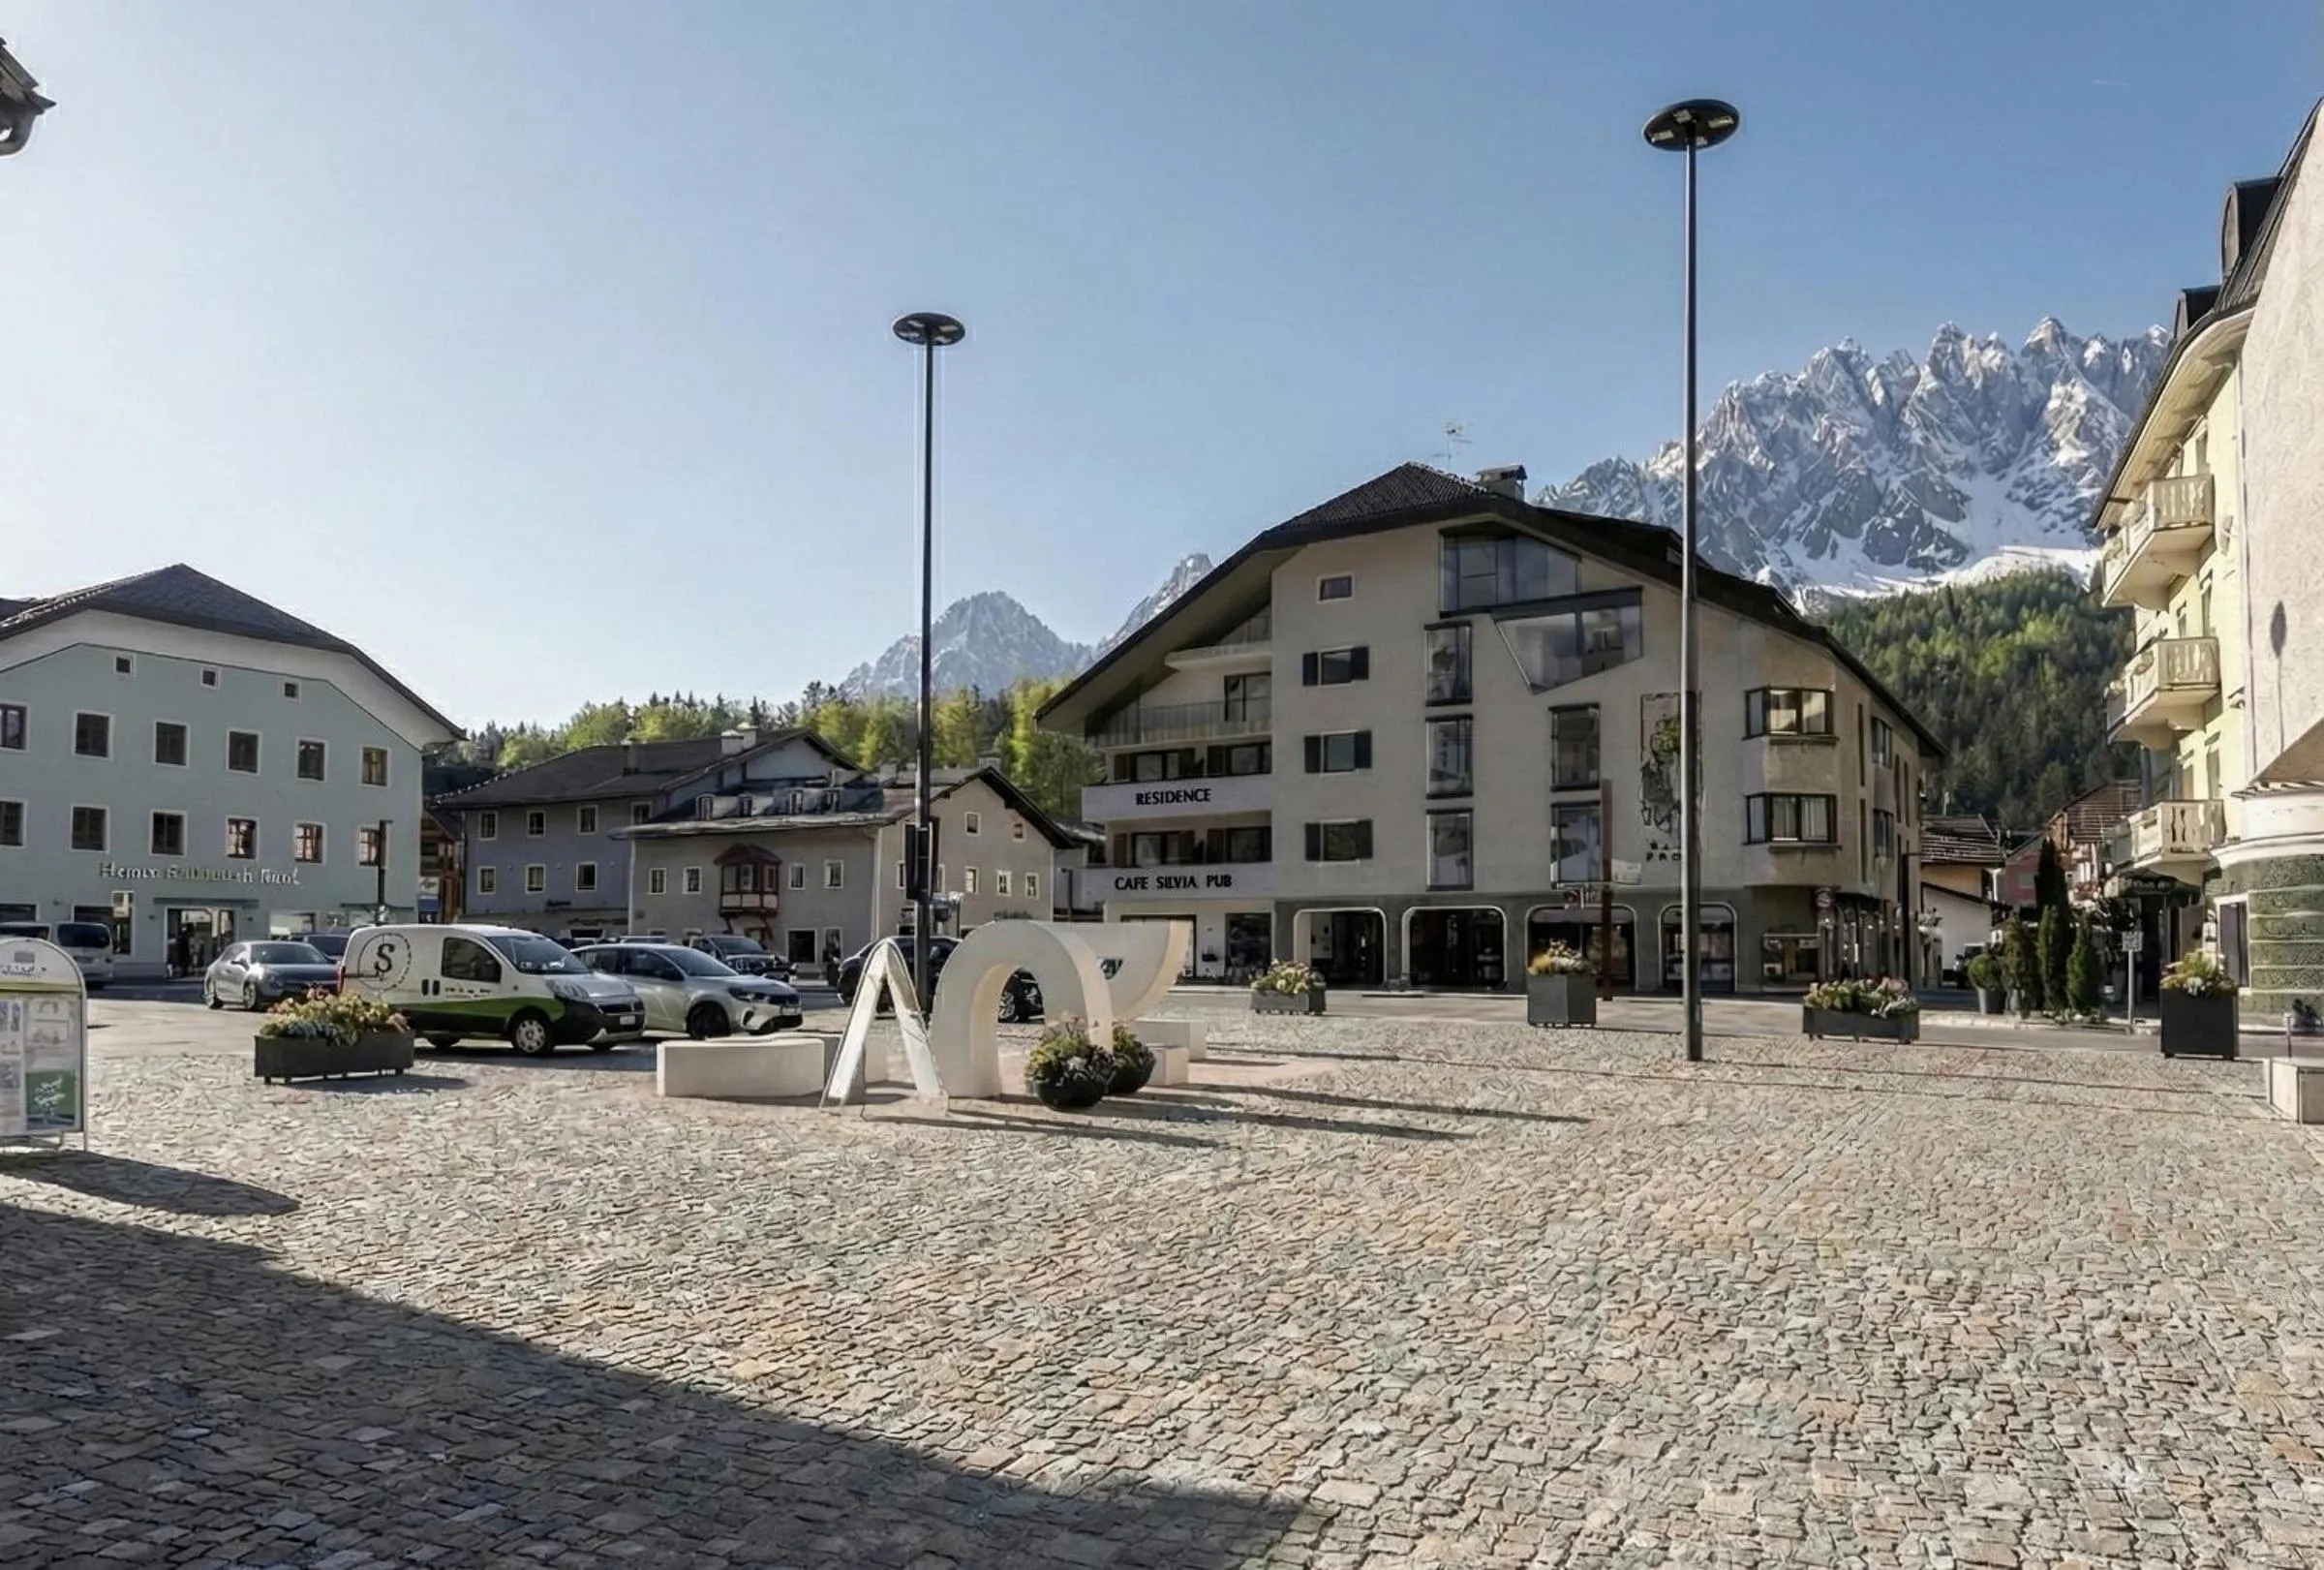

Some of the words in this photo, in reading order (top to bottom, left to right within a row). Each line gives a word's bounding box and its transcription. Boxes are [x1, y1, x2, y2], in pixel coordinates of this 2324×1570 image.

[1135, 788, 1211, 806] RESIDENCE
[1115, 877, 1148, 890] CAFE
[1156, 876, 1198, 889] SILVIA
[1207, 874, 1233, 887] PUB
[374, 942, 396, 973] S
